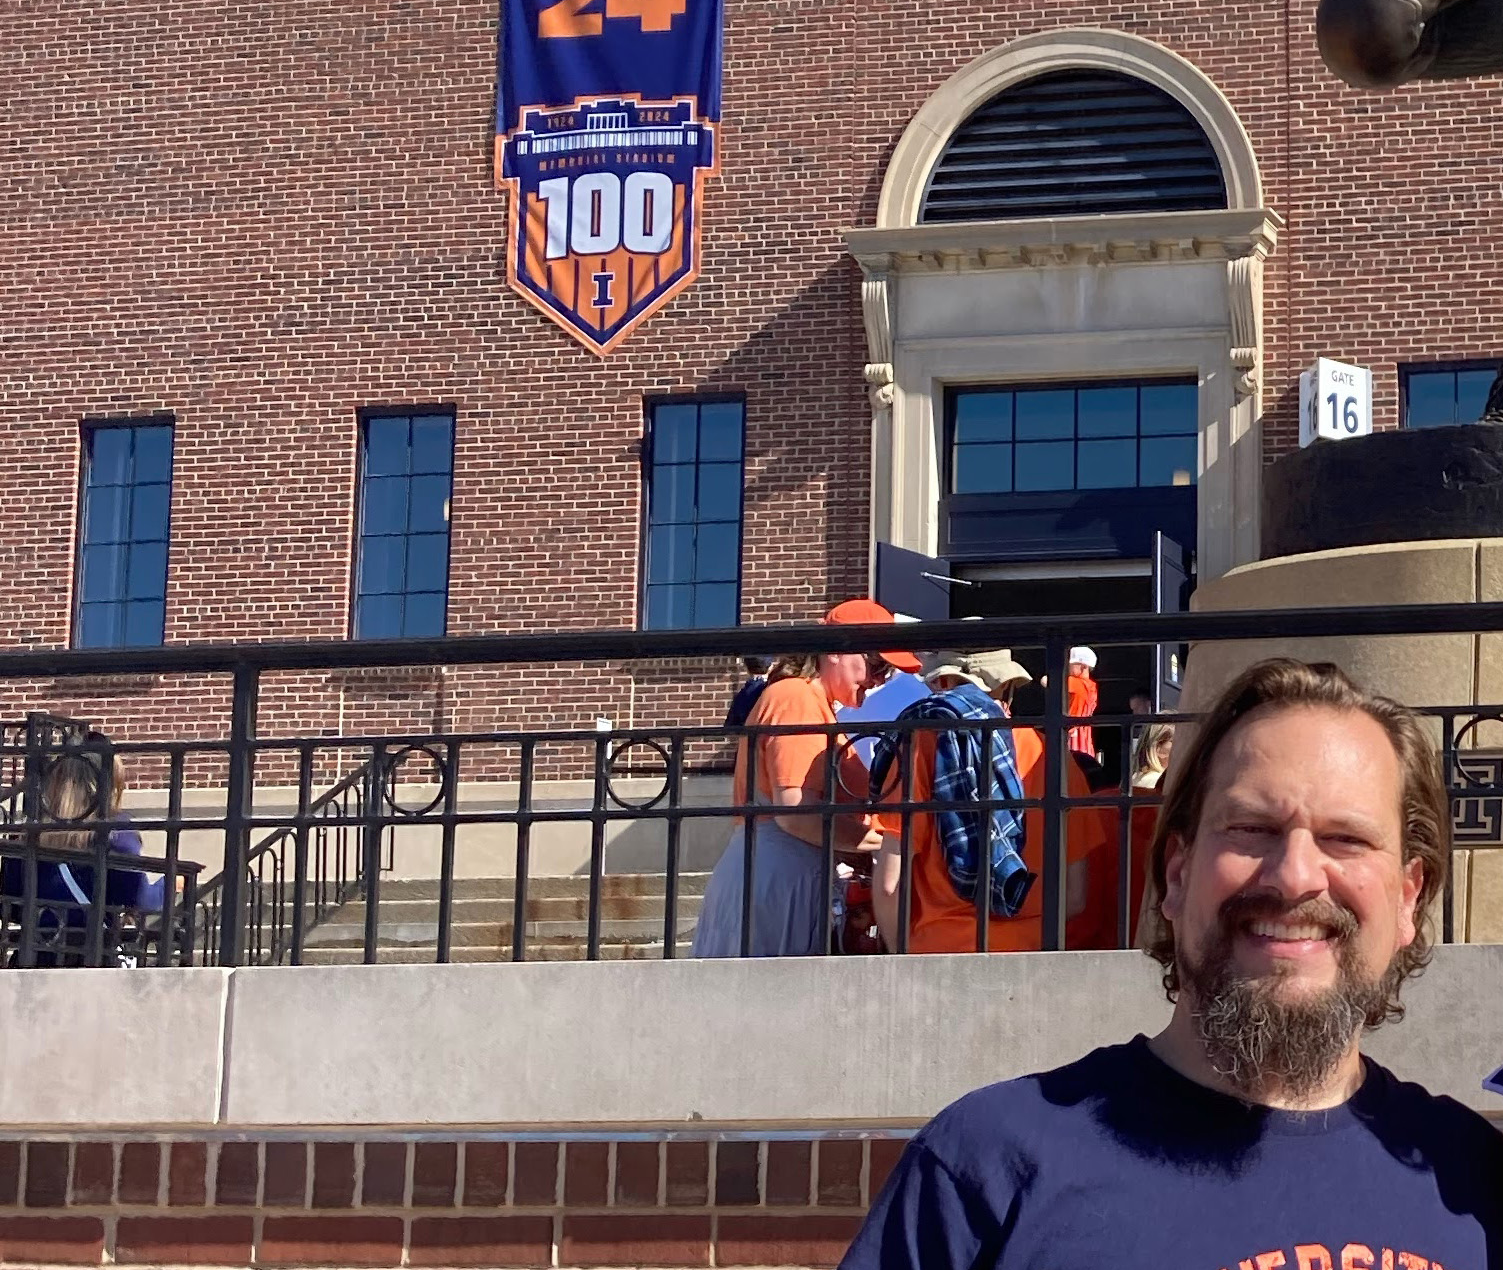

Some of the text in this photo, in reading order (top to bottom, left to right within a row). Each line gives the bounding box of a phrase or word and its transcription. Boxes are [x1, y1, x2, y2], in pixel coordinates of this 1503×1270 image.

[537, 171, 674, 259] 100
[1331, 370, 1355, 387] GATE
[1326, 392, 1359, 434] 16
